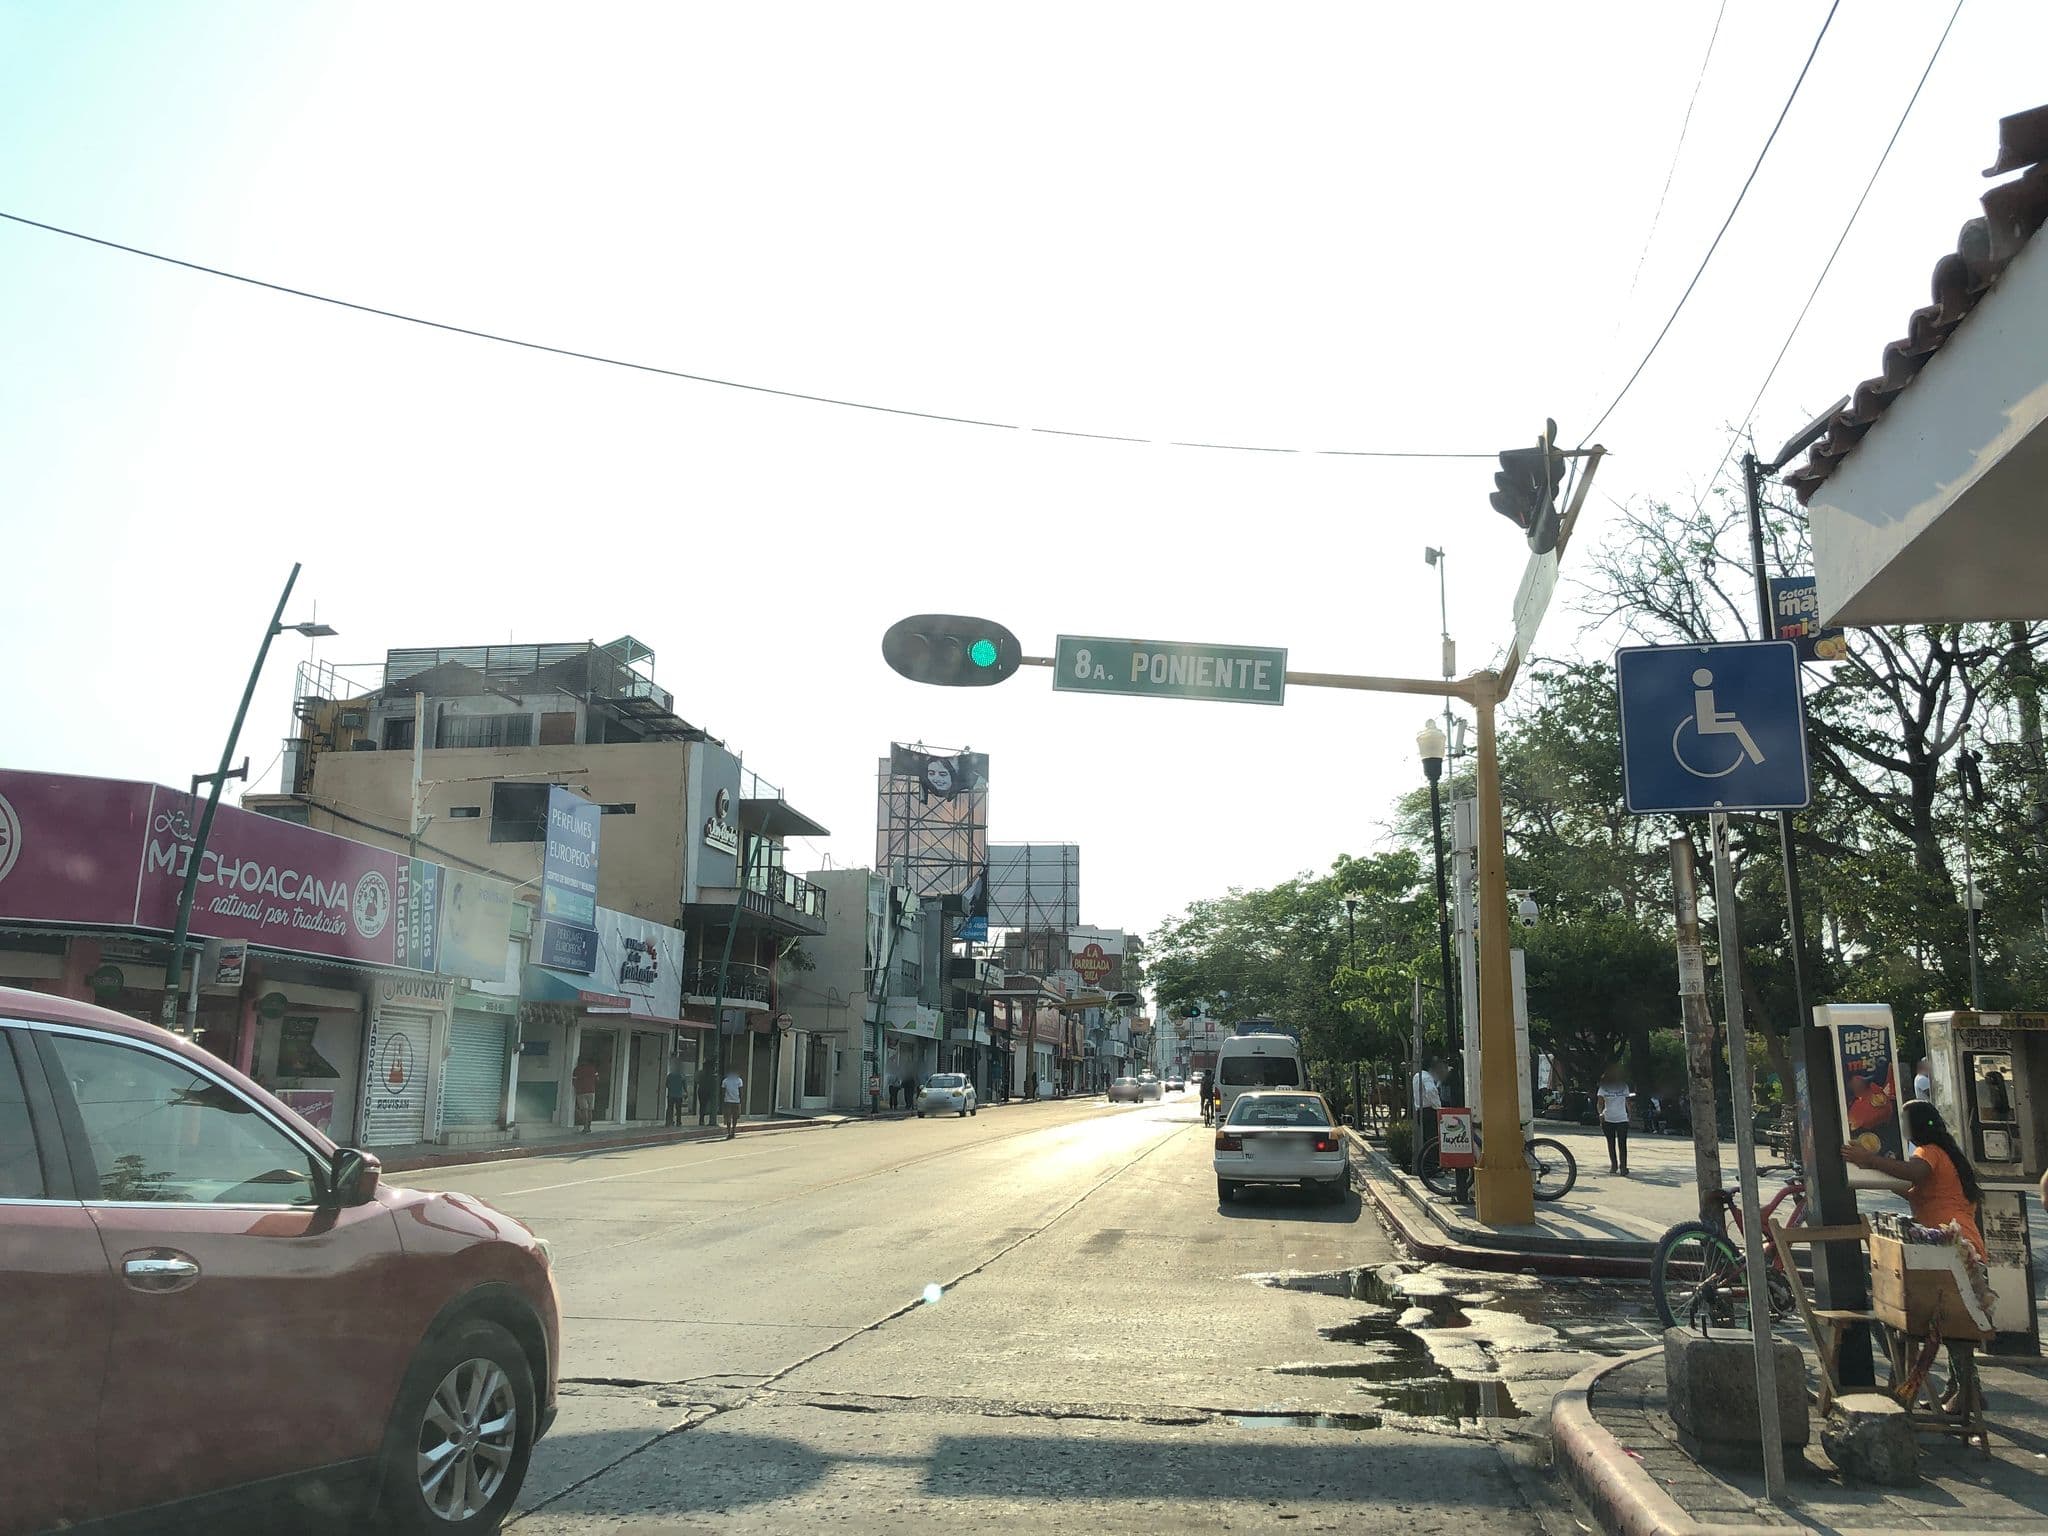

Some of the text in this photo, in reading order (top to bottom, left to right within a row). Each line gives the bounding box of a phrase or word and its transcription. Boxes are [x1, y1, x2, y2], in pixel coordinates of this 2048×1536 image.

[1779, 594, 1819, 616] ma
[1781, 618, 1831, 639] mig
[1130, 652, 1272, 691] PONIENTE
[552, 808, 592, 839] PERFUMES
[549, 840, 591, 869] EUROPEOS
[148, 839, 349, 912] MICHOACANA
[208, 893, 262, 923] natural
[262, 908, 289, 928] por
[292, 906, 347, 936] tradición
[397, 865, 409, 959] Helados
[410, 879, 422, 949] Aguas
[423, 878, 434, 958] Paletas
[1074, 959, 1110, 971] PARRILLADA
[1086, 948, 1098, 958] LA
[1845, 1029, 1879, 1042] Habla
[361, 1012, 379, 1144] LABORATORIO
[377, 1098, 410, 1109] ROVISAN
[1442, 1131, 1470, 1144] Tuxtla
